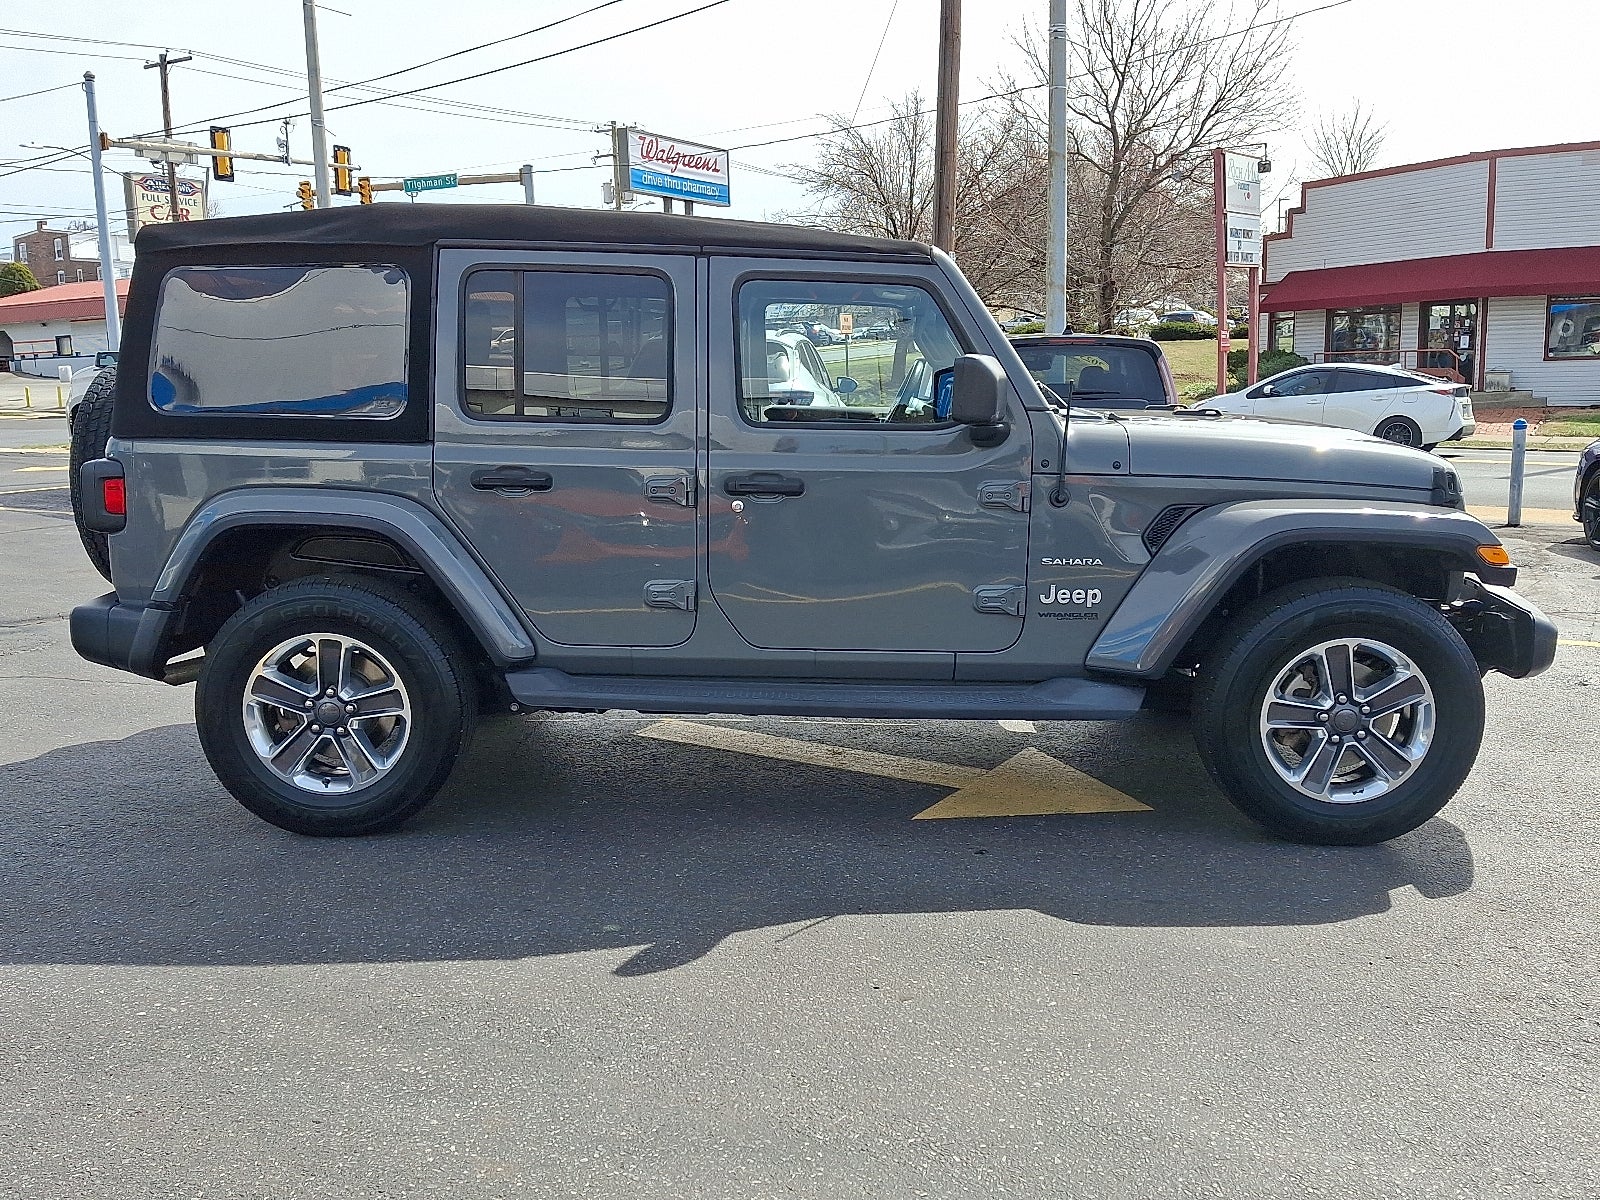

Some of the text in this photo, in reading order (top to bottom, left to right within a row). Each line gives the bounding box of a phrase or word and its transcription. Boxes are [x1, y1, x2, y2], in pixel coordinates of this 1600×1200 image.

[638, 136, 720, 173] Walgreens
[406, 176, 455, 190] Tilghman St
[642, 171, 720, 199] drive thru pharmacy
[142, 193, 198, 206] FULL SVICE
[1041, 557, 1103, 566] SAHARA
[1039, 584, 1102, 608] Jeep
